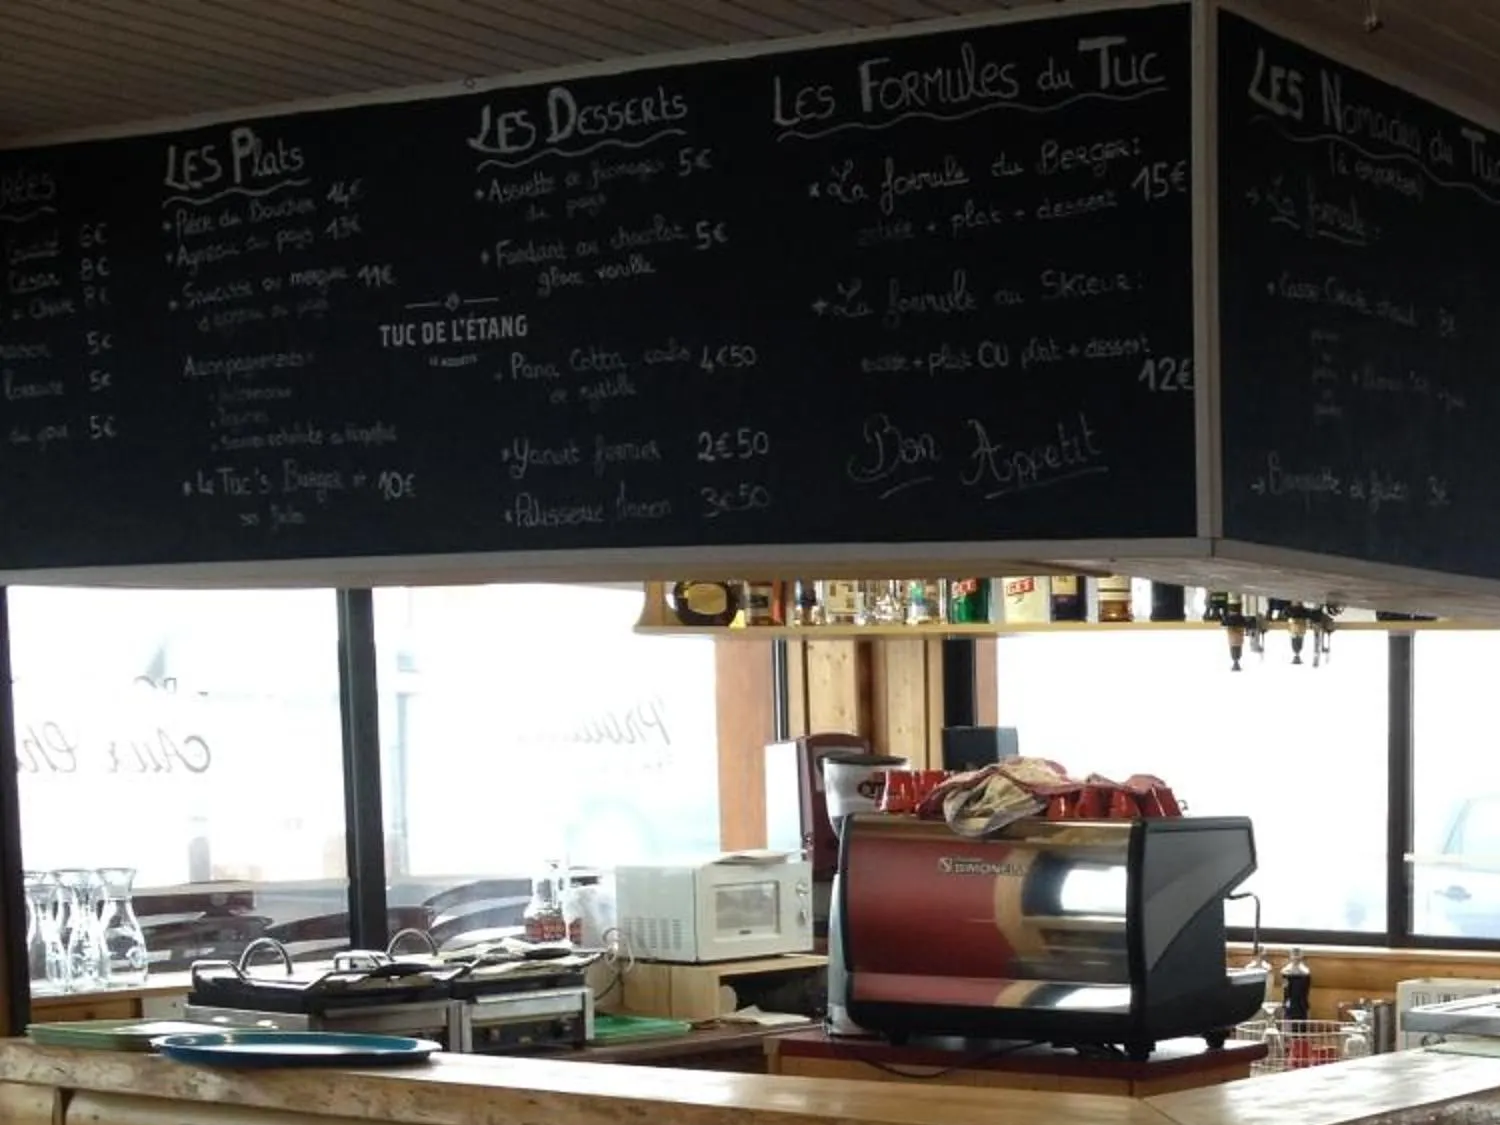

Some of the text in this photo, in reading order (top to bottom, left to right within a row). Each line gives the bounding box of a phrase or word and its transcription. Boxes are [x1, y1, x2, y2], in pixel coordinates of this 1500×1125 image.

[1036, 66, 1074, 92] du
[1247, 47, 1305, 121] LES
[466, 103, 537, 154] LES
[163, 127, 305, 191] LES Plats
[677, 146, 714, 177] 5€
[879, 155, 972, 216] formule
[1130, 160, 1189, 203] 15€
[694, 219, 730, 251] 5€
[950, 198, 1004, 239] plat
[356, 263, 398, 288] 11€
[883, 268, 979, 330] formule
[378, 310, 528, 348] TUC DE L'ÉTANG
[511, 350, 562, 380] Pana
[977, 340, 1010, 369] OU
[1138, 356, 1195, 392] 12€
[847, 412, 941, 483] Bon
[377, 470, 416, 501] 10€
